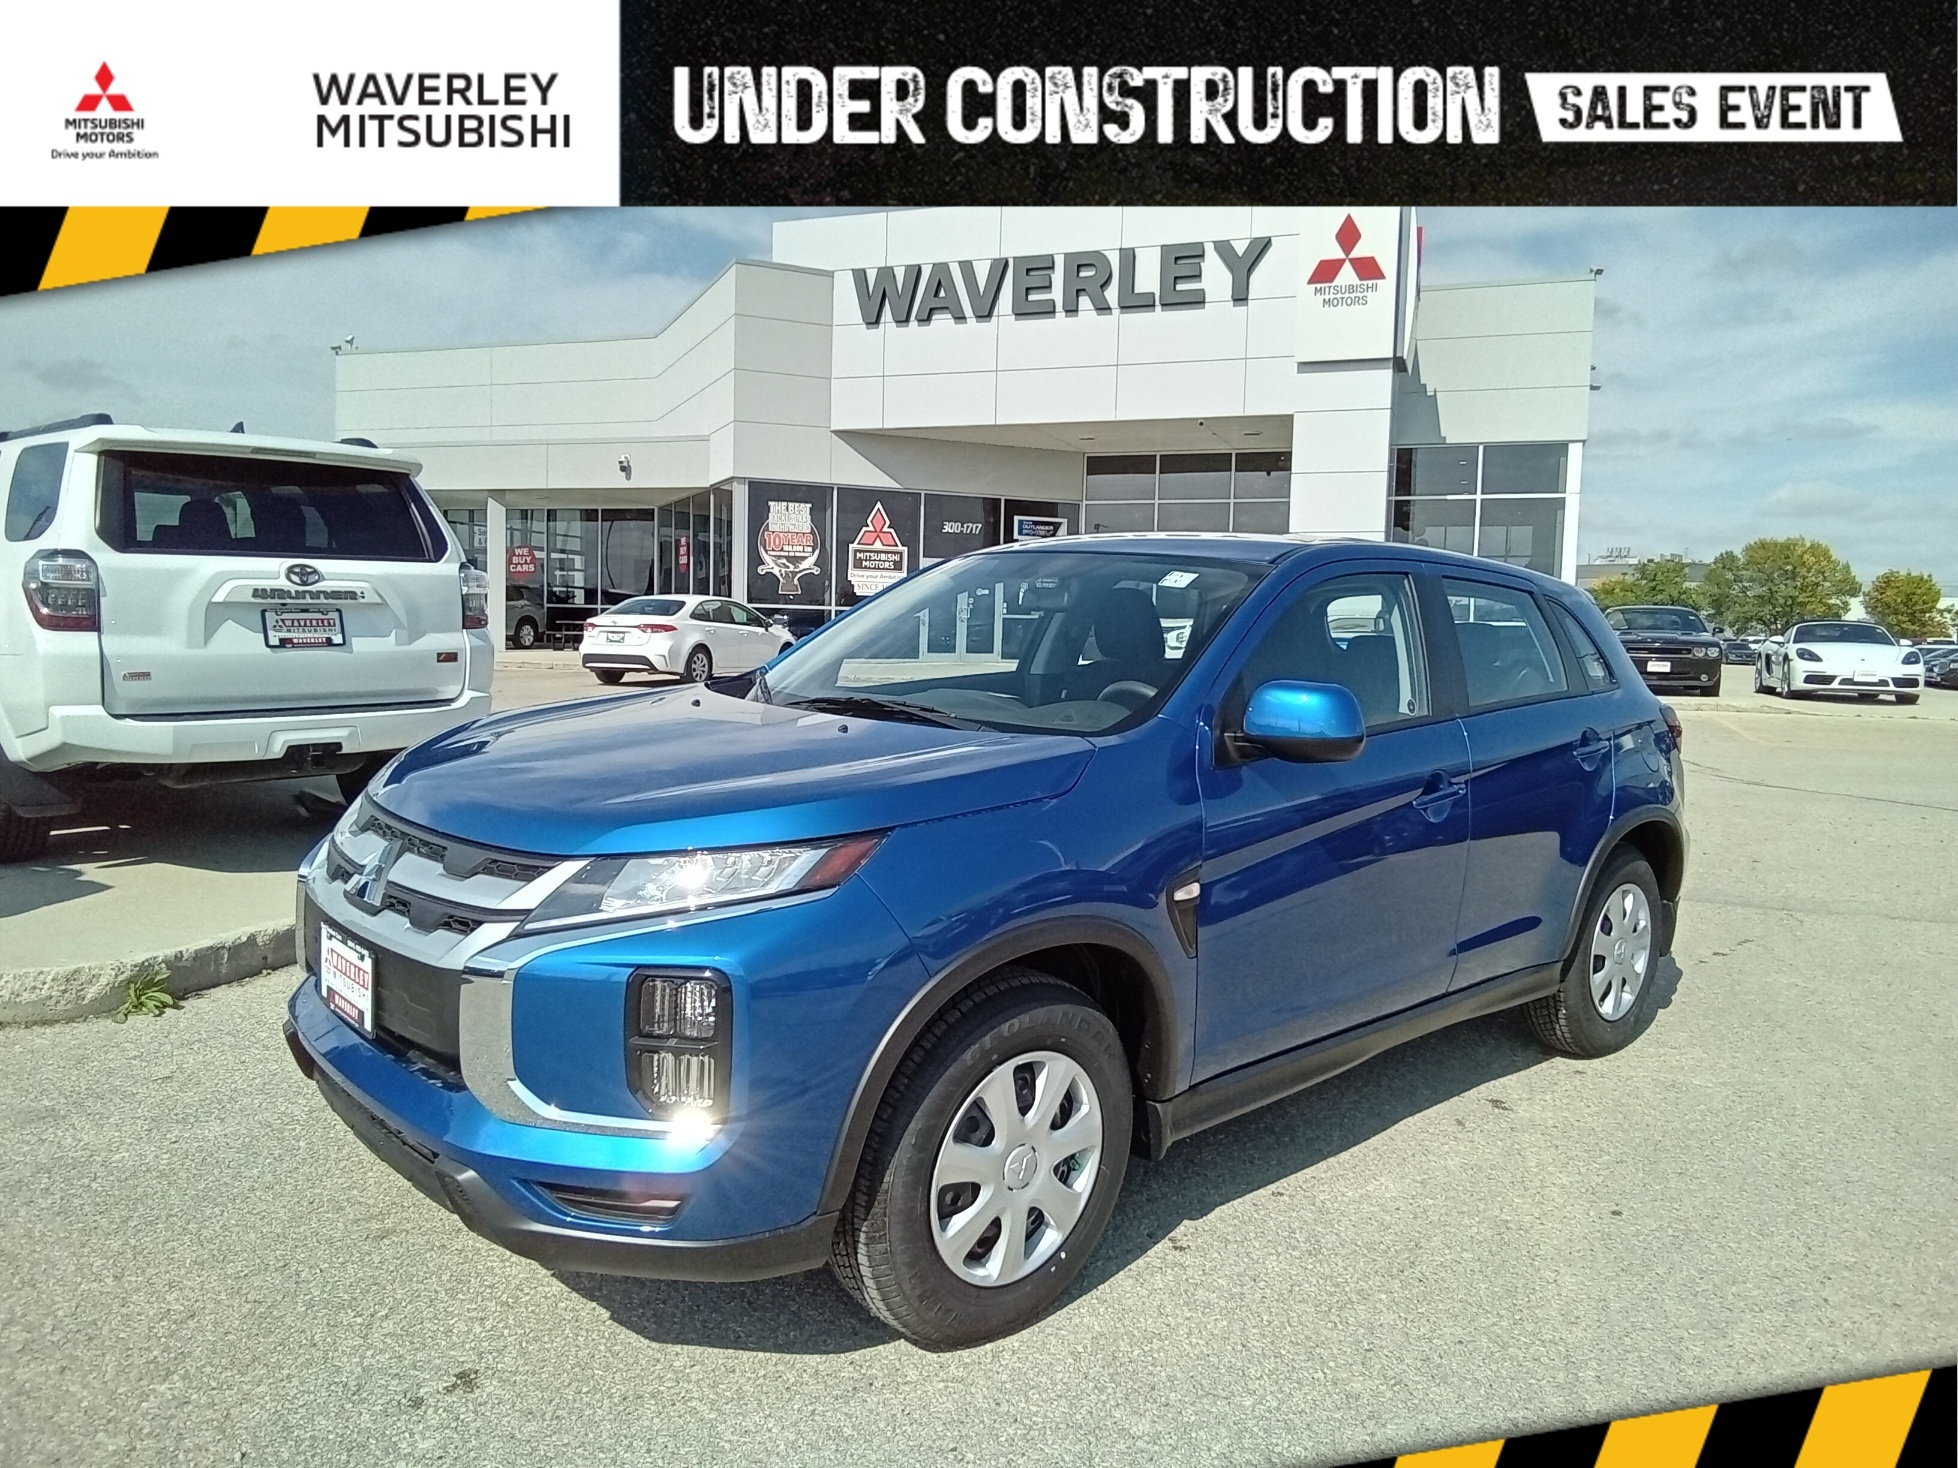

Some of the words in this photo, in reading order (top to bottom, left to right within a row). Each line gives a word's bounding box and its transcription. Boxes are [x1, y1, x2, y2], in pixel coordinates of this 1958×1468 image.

[852, 237, 1272, 328] WAVERLEY
[1314, 282, 1378, 296] MITSUBISHI
[1322, 295, 1368, 308] MOTORS
[768, 501, 788, 514] THE
[788, 502, 812, 516] BEST
[941, 521, 982, 534] 300-1717
[765, 531, 782, 550] 10
[782, 533, 813, 546] YEAR
[514, 548, 530, 556] WE
[856, 552, 900, 561] MITSUBISHI
[512, 556, 532, 564] BUY
[862, 561, 894, 569] MOTORS
[509, 564, 535, 572] CARS
[856, 583, 880, 591] SINCE
[284, 618, 335, 628] WAVERLEY
[331, 950, 370, 989] WAVERLEY
[334, 993, 360, 1021] WAVERLEY
